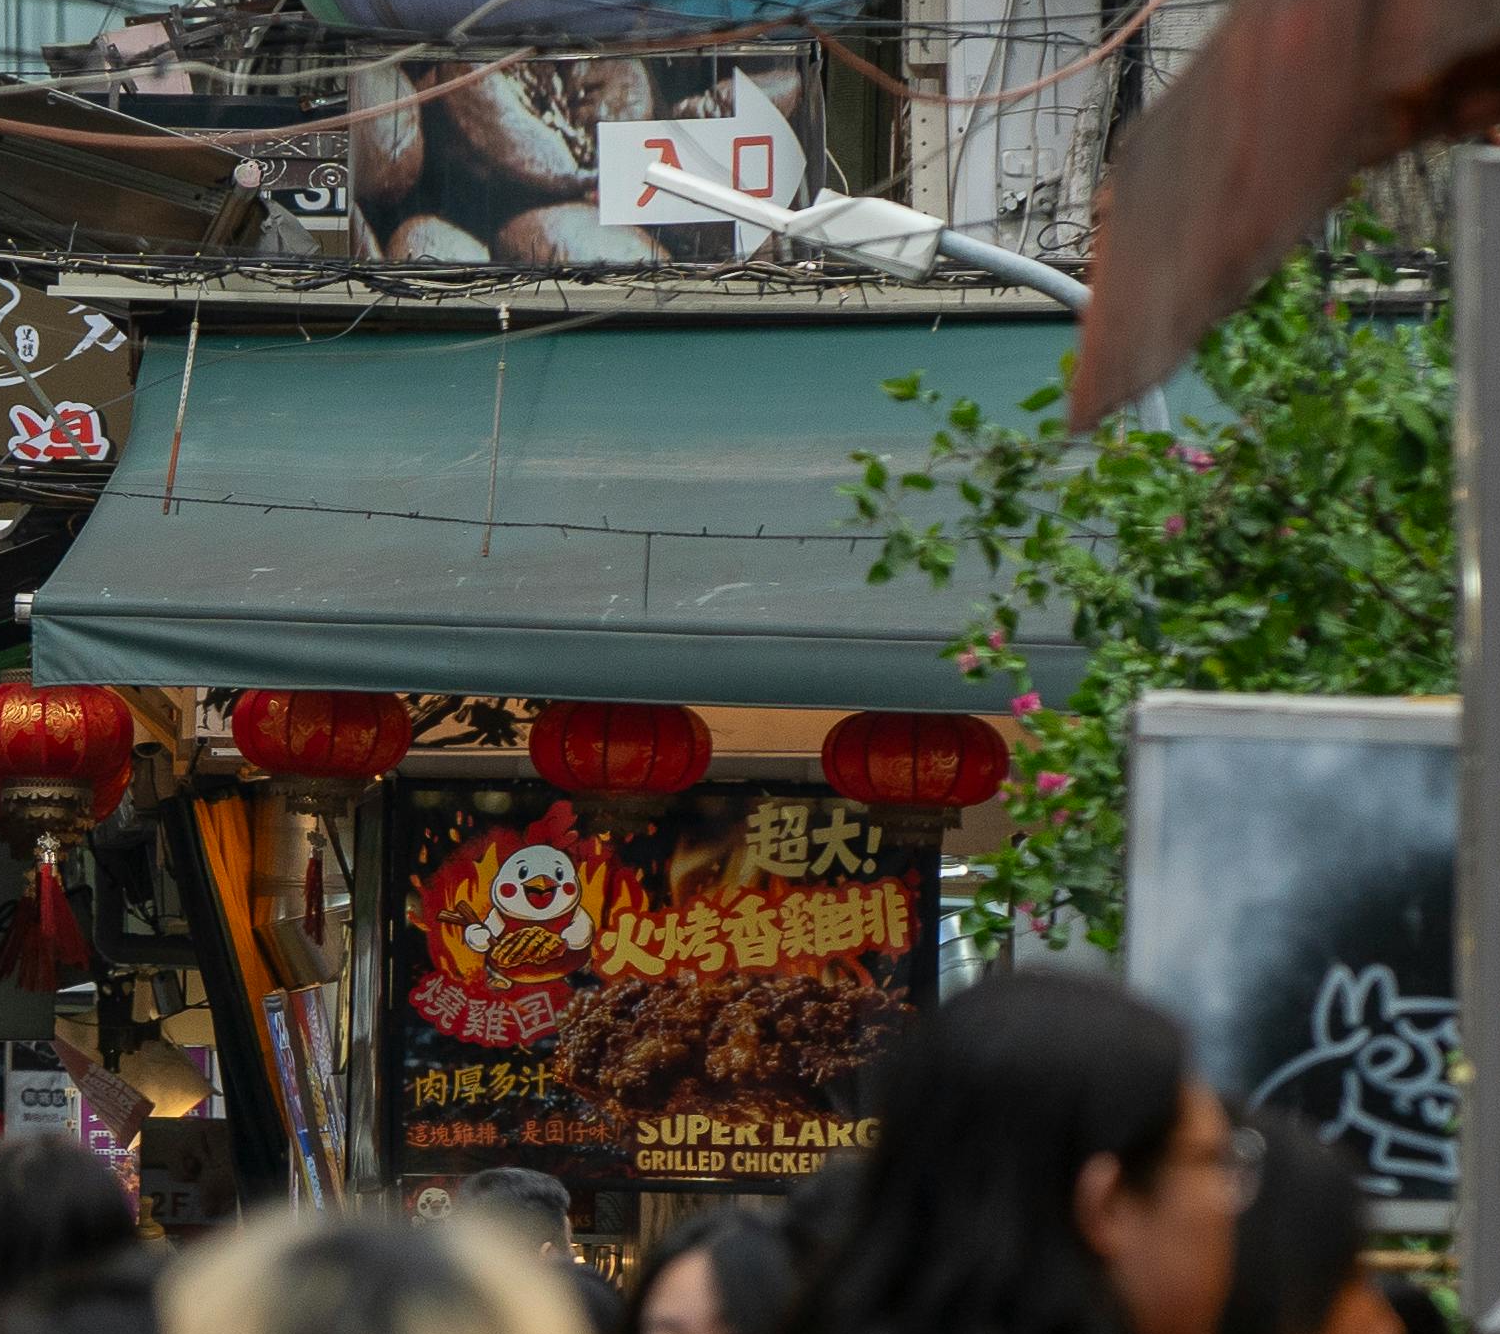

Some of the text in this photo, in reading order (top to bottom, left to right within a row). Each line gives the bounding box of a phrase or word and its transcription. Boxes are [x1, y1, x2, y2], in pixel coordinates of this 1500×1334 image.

[601, 882, 909, 976] 火烤香雞排
[415, 1062, 554, 1108] 肉厚多汁
[636, 1113, 884, 1149] SUPER LARG
[636, 1149, 827, 1175] GRILLED CHICKEN
